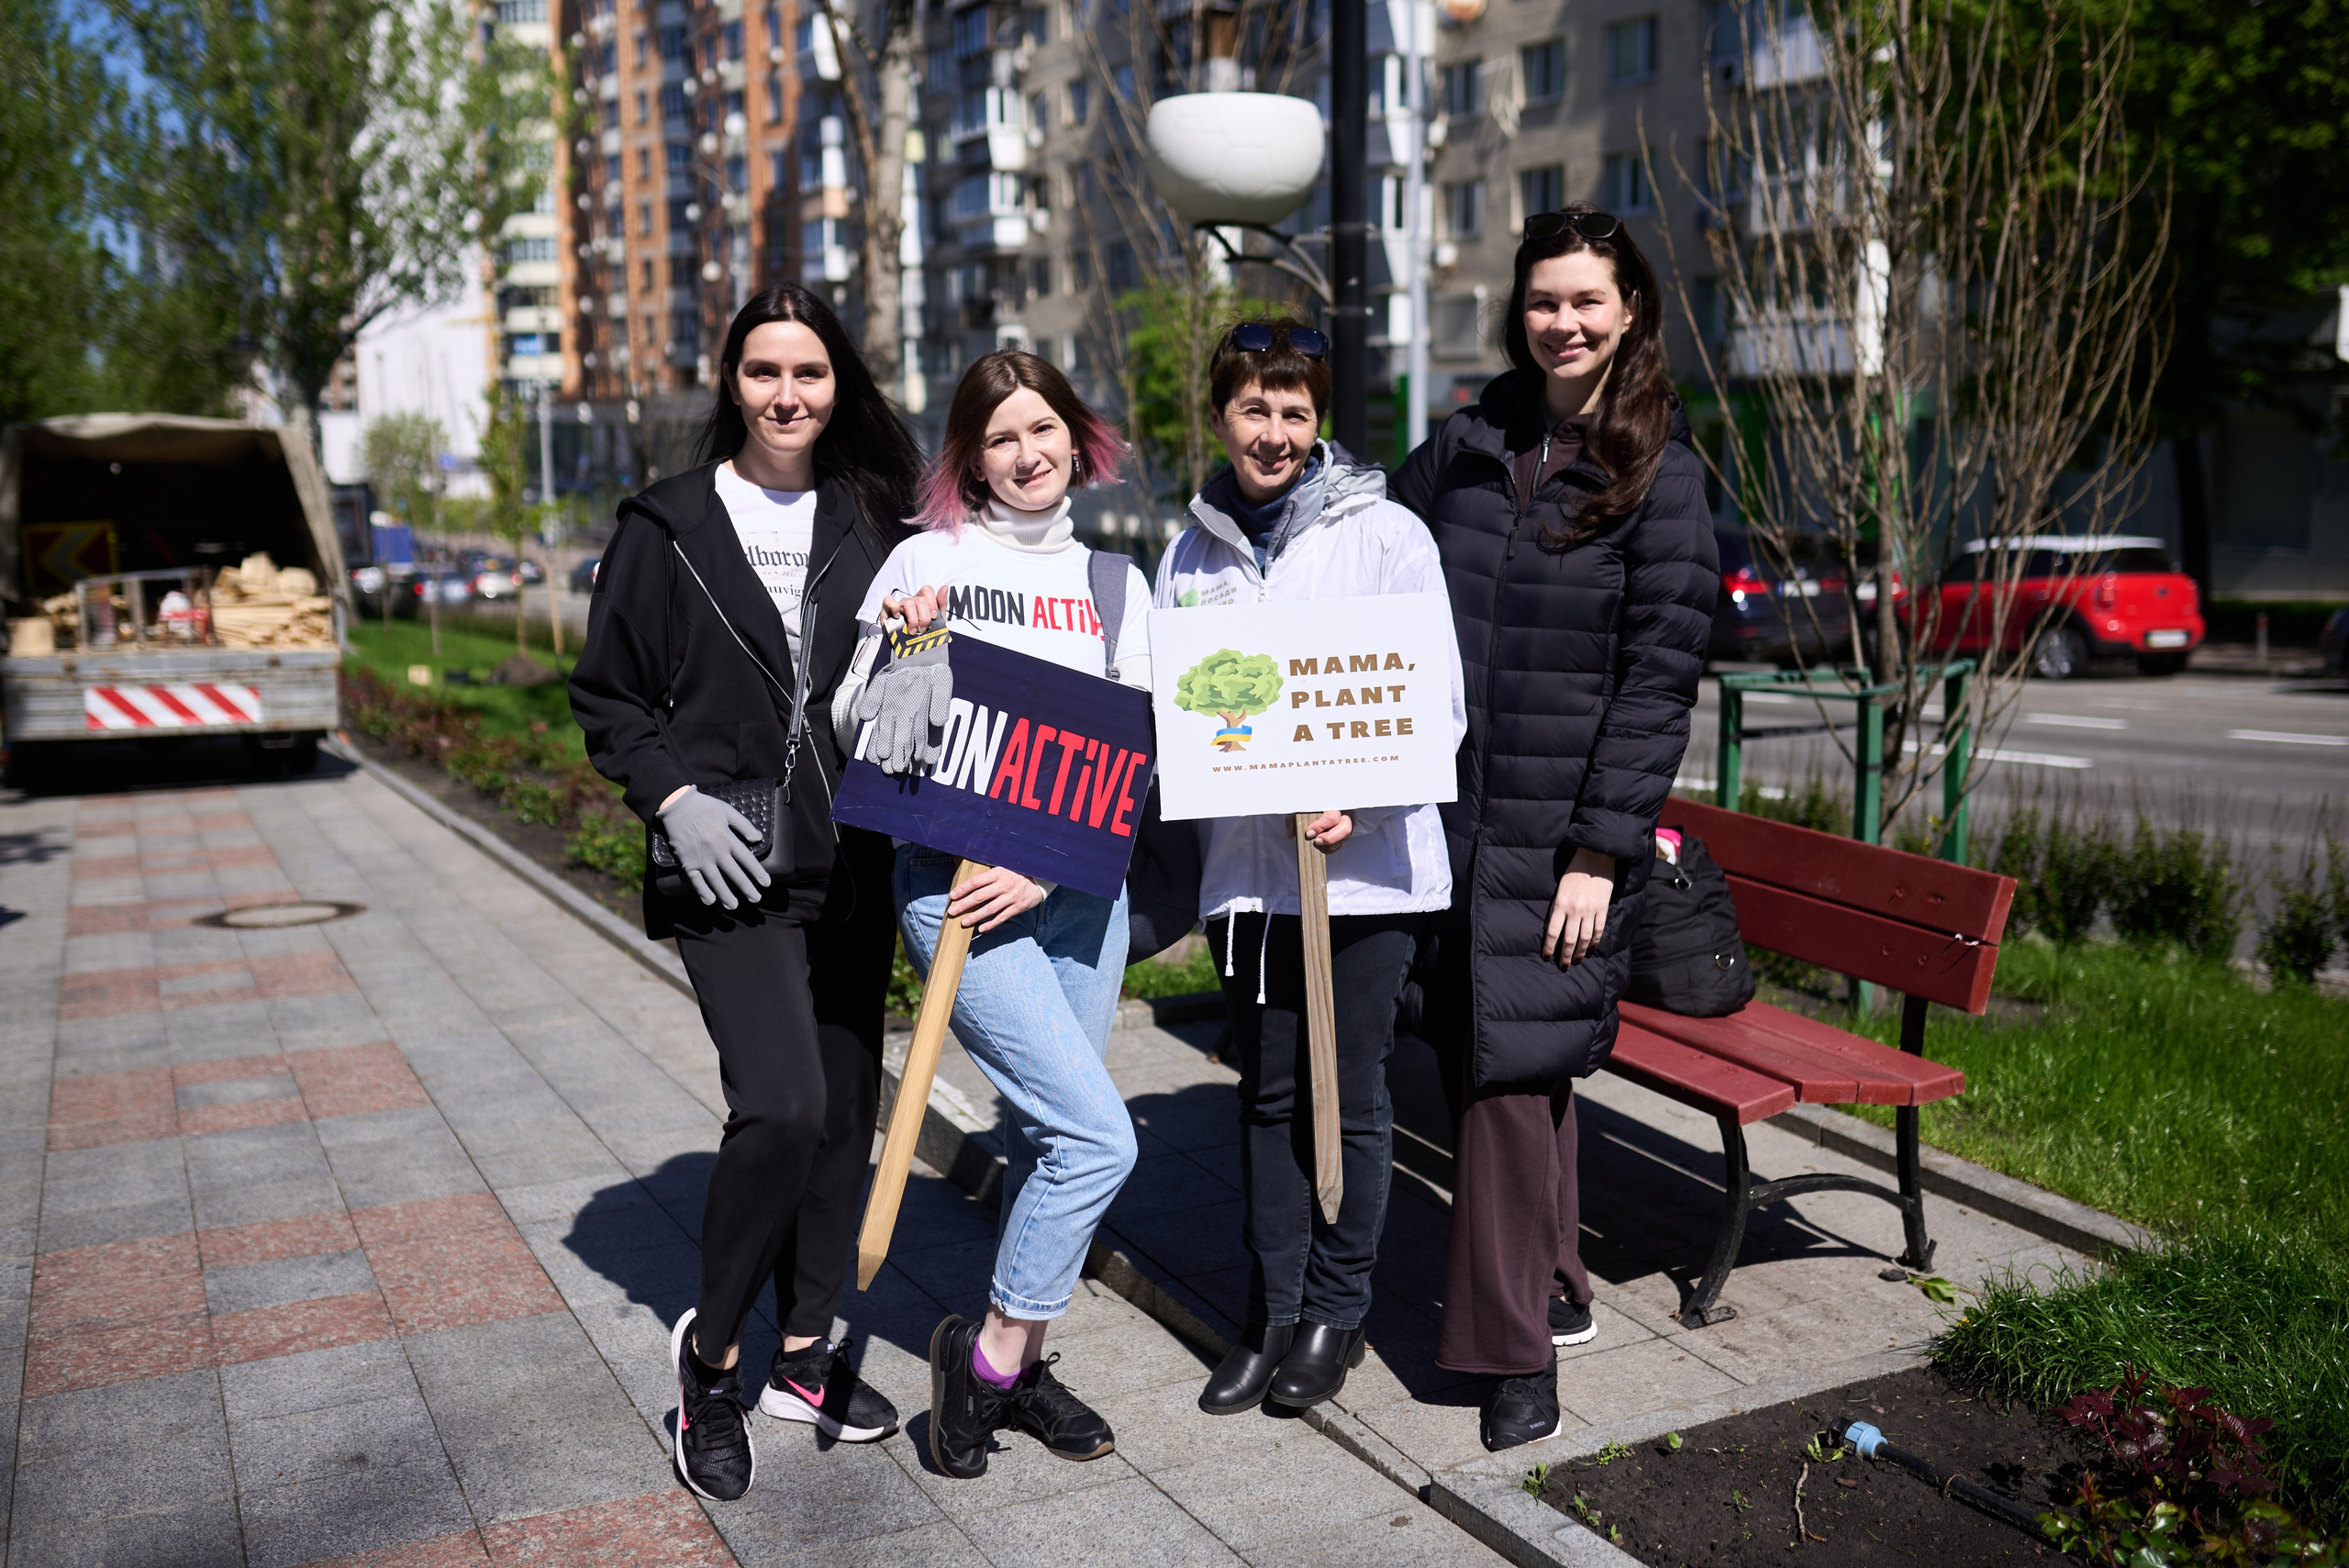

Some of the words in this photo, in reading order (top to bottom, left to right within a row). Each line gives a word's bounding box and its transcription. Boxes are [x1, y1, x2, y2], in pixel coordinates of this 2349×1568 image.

[947, 585, 1026, 627] MOON
[1032, 595, 1105, 642] ACTiV
[1288, 652, 1416, 676] MAMA,
[1291, 684, 1406, 709] PLANT
[1292, 724, 1314, 742] A
[1326, 717, 1414, 740] TREE
[1212, 755, 1399, 773] WWW.MAMAPLANTATREE.COM
